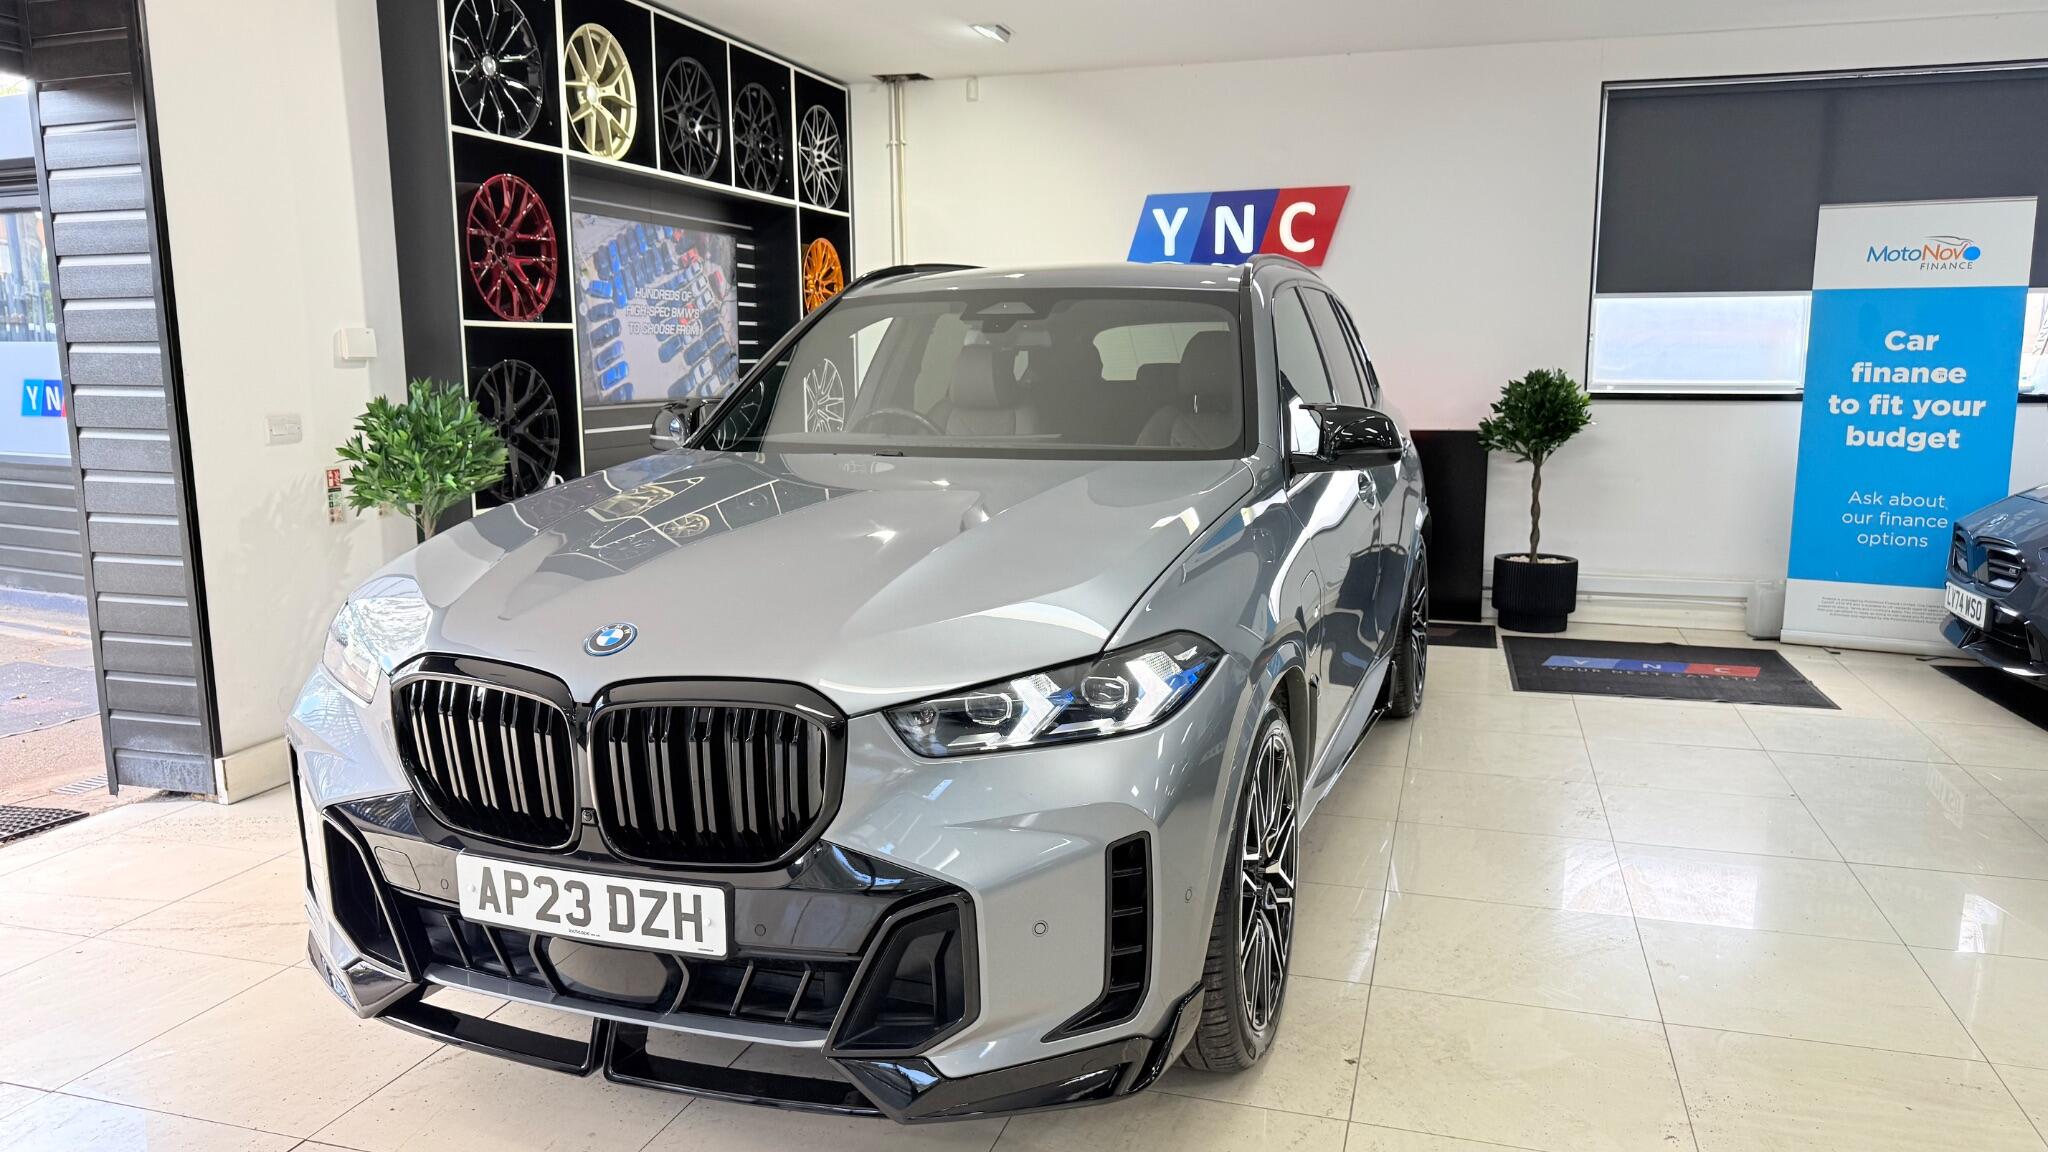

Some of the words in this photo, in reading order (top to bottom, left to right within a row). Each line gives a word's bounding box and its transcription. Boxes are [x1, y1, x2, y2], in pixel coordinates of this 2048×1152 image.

[1152, 201, 1316, 256] YNC
[1919, 261, 1973, 270] FINANCE
[635, 287, 680, 301] HUNDREDS
[681, 291, 692, 302] OF
[629, 322, 640, 335] TO
[641, 323, 675, 335] CHOOSE
[1884, 330, 1940, 351] Car
[1851, 361, 1967, 384] finance
[26, 385, 63, 411] YN
[1828, 394, 1860, 415] to
[1868, 393, 1903, 415] fit
[1912, 398, 1987, 420] your
[1845, 425, 1961, 452] budget
[1848, 490, 1883, 505] Ask
[1889, 491, 1945, 508] about
[1841, 513, 1871, 524] our
[1879, 512, 1948, 529] finance
[1857, 533, 1929, 548] options
[478, 867, 592, 928] AP23
[606, 885, 704, 942] DZH
